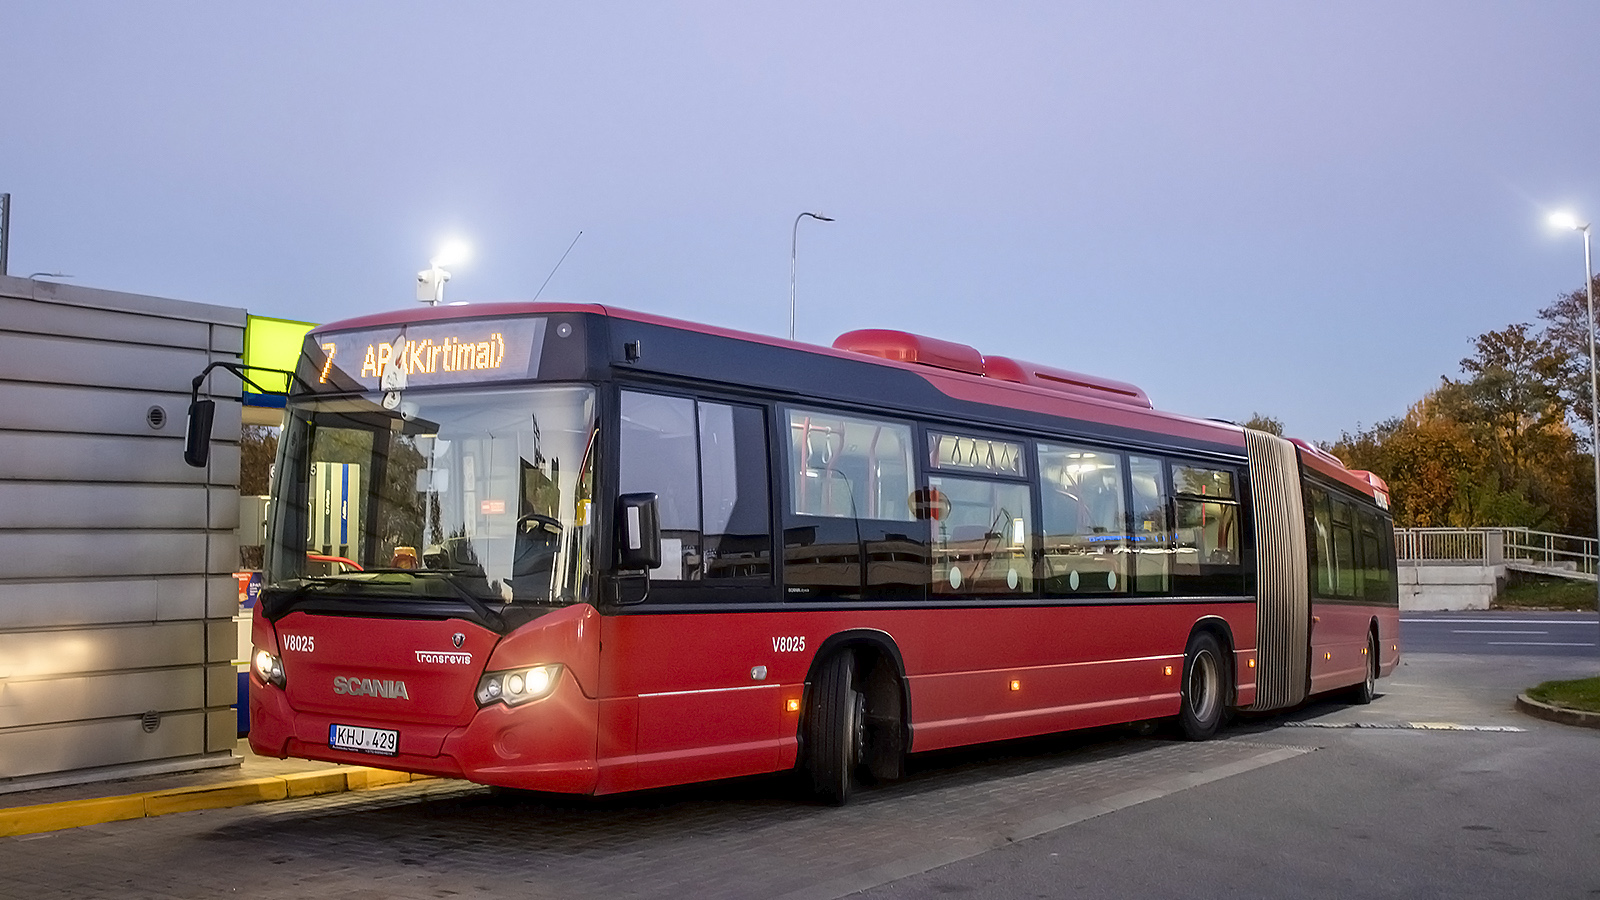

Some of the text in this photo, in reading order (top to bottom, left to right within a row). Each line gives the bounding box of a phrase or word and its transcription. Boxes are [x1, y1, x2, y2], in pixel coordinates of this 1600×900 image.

[319, 343, 336, 384] 7
[403, 333, 505, 375] (Kirtimai)
[283, 634, 315, 652] V8025
[772, 636, 806, 652] V8025
[415, 650, 473, 665] Transrevis
[333, 675, 410, 700] SCANIA
[337, 727, 395, 750] KHJ 429
